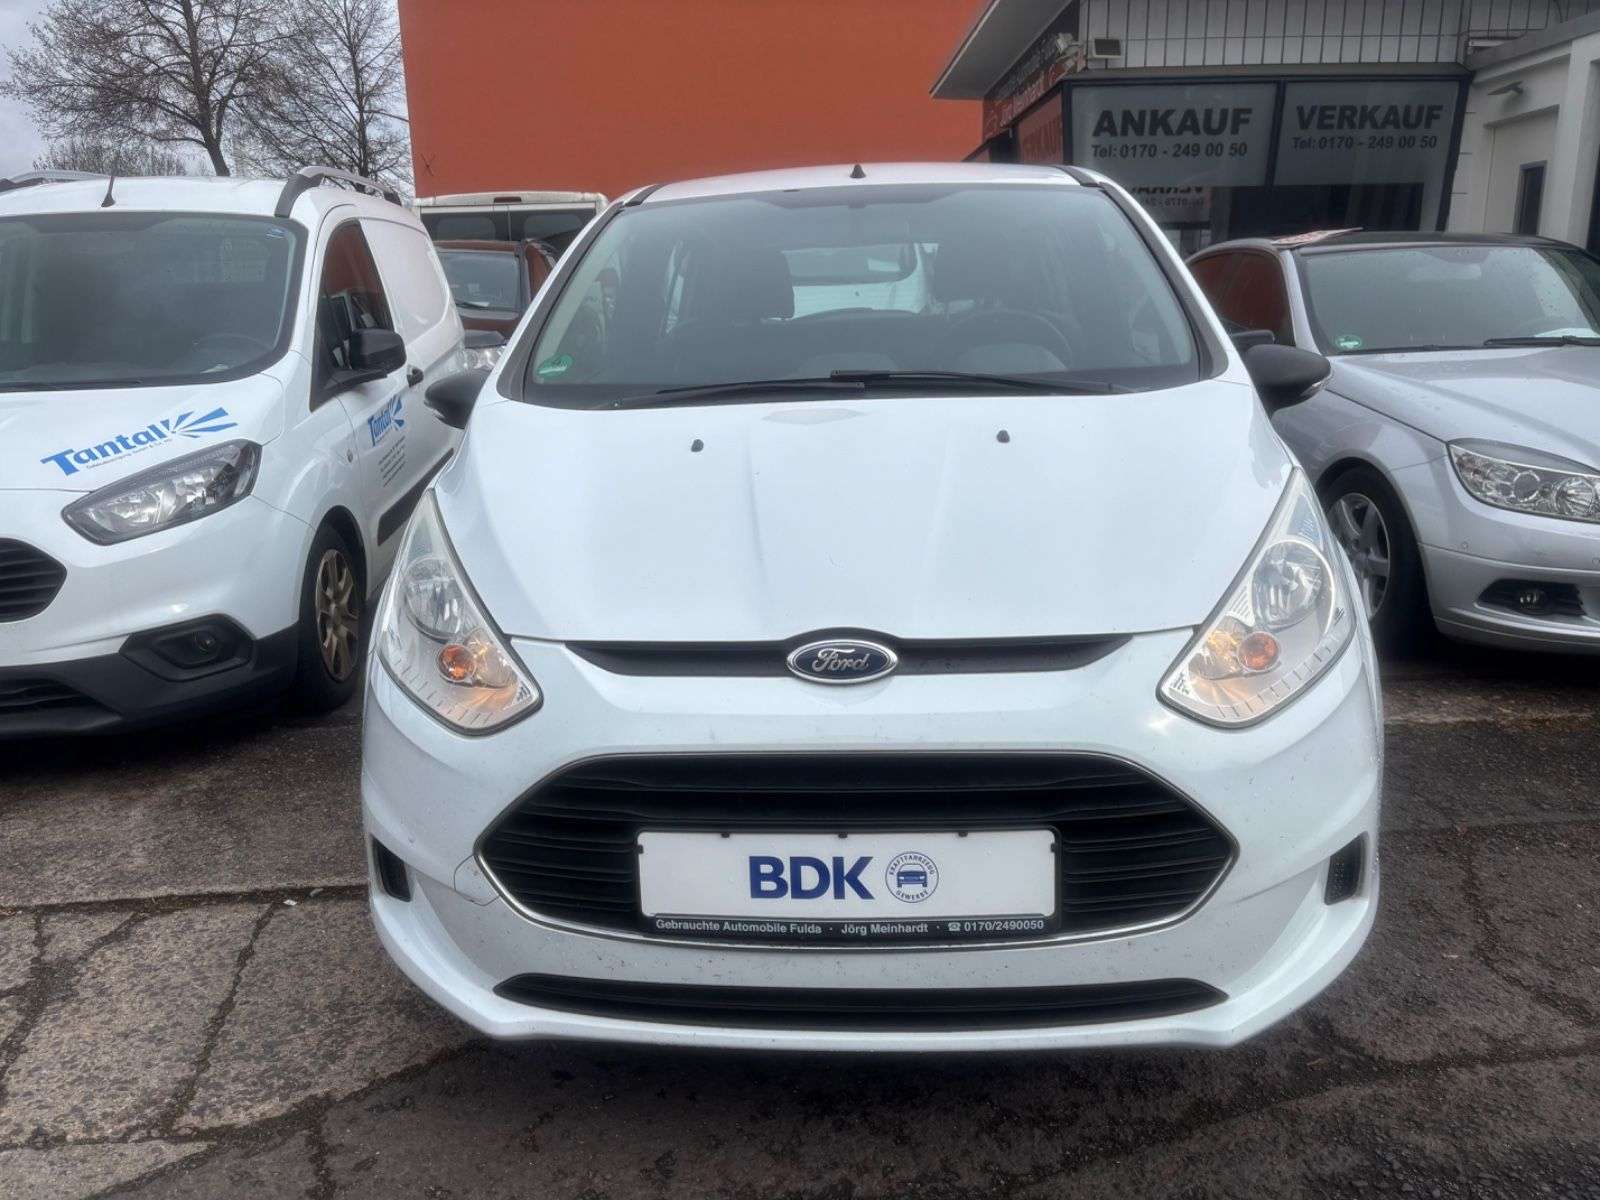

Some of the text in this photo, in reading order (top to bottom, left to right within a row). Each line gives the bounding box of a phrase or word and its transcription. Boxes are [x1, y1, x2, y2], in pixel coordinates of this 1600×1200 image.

[1092, 108, 1253, 137] ANKAUF
[1297, 104, 1443, 130] VERKAUF
[1172, 143, 1200, 157] 249
[1205, 143, 1224, 157] 00
[1228, 142, 1248, 156] 50
[1368, 136, 1394, 149] 249
[1398, 136, 1416, 149] 00
[1420, 135, 1437, 149] 50
[40, 420, 168, 476] Tantal
[812, 648, 870, 672] Ford
[749, 856, 875, 900] BDK
[656, 919, 1044, 935] Gebrauchte Automobile Fulda Jörg Meinhardt 0170/2490050
